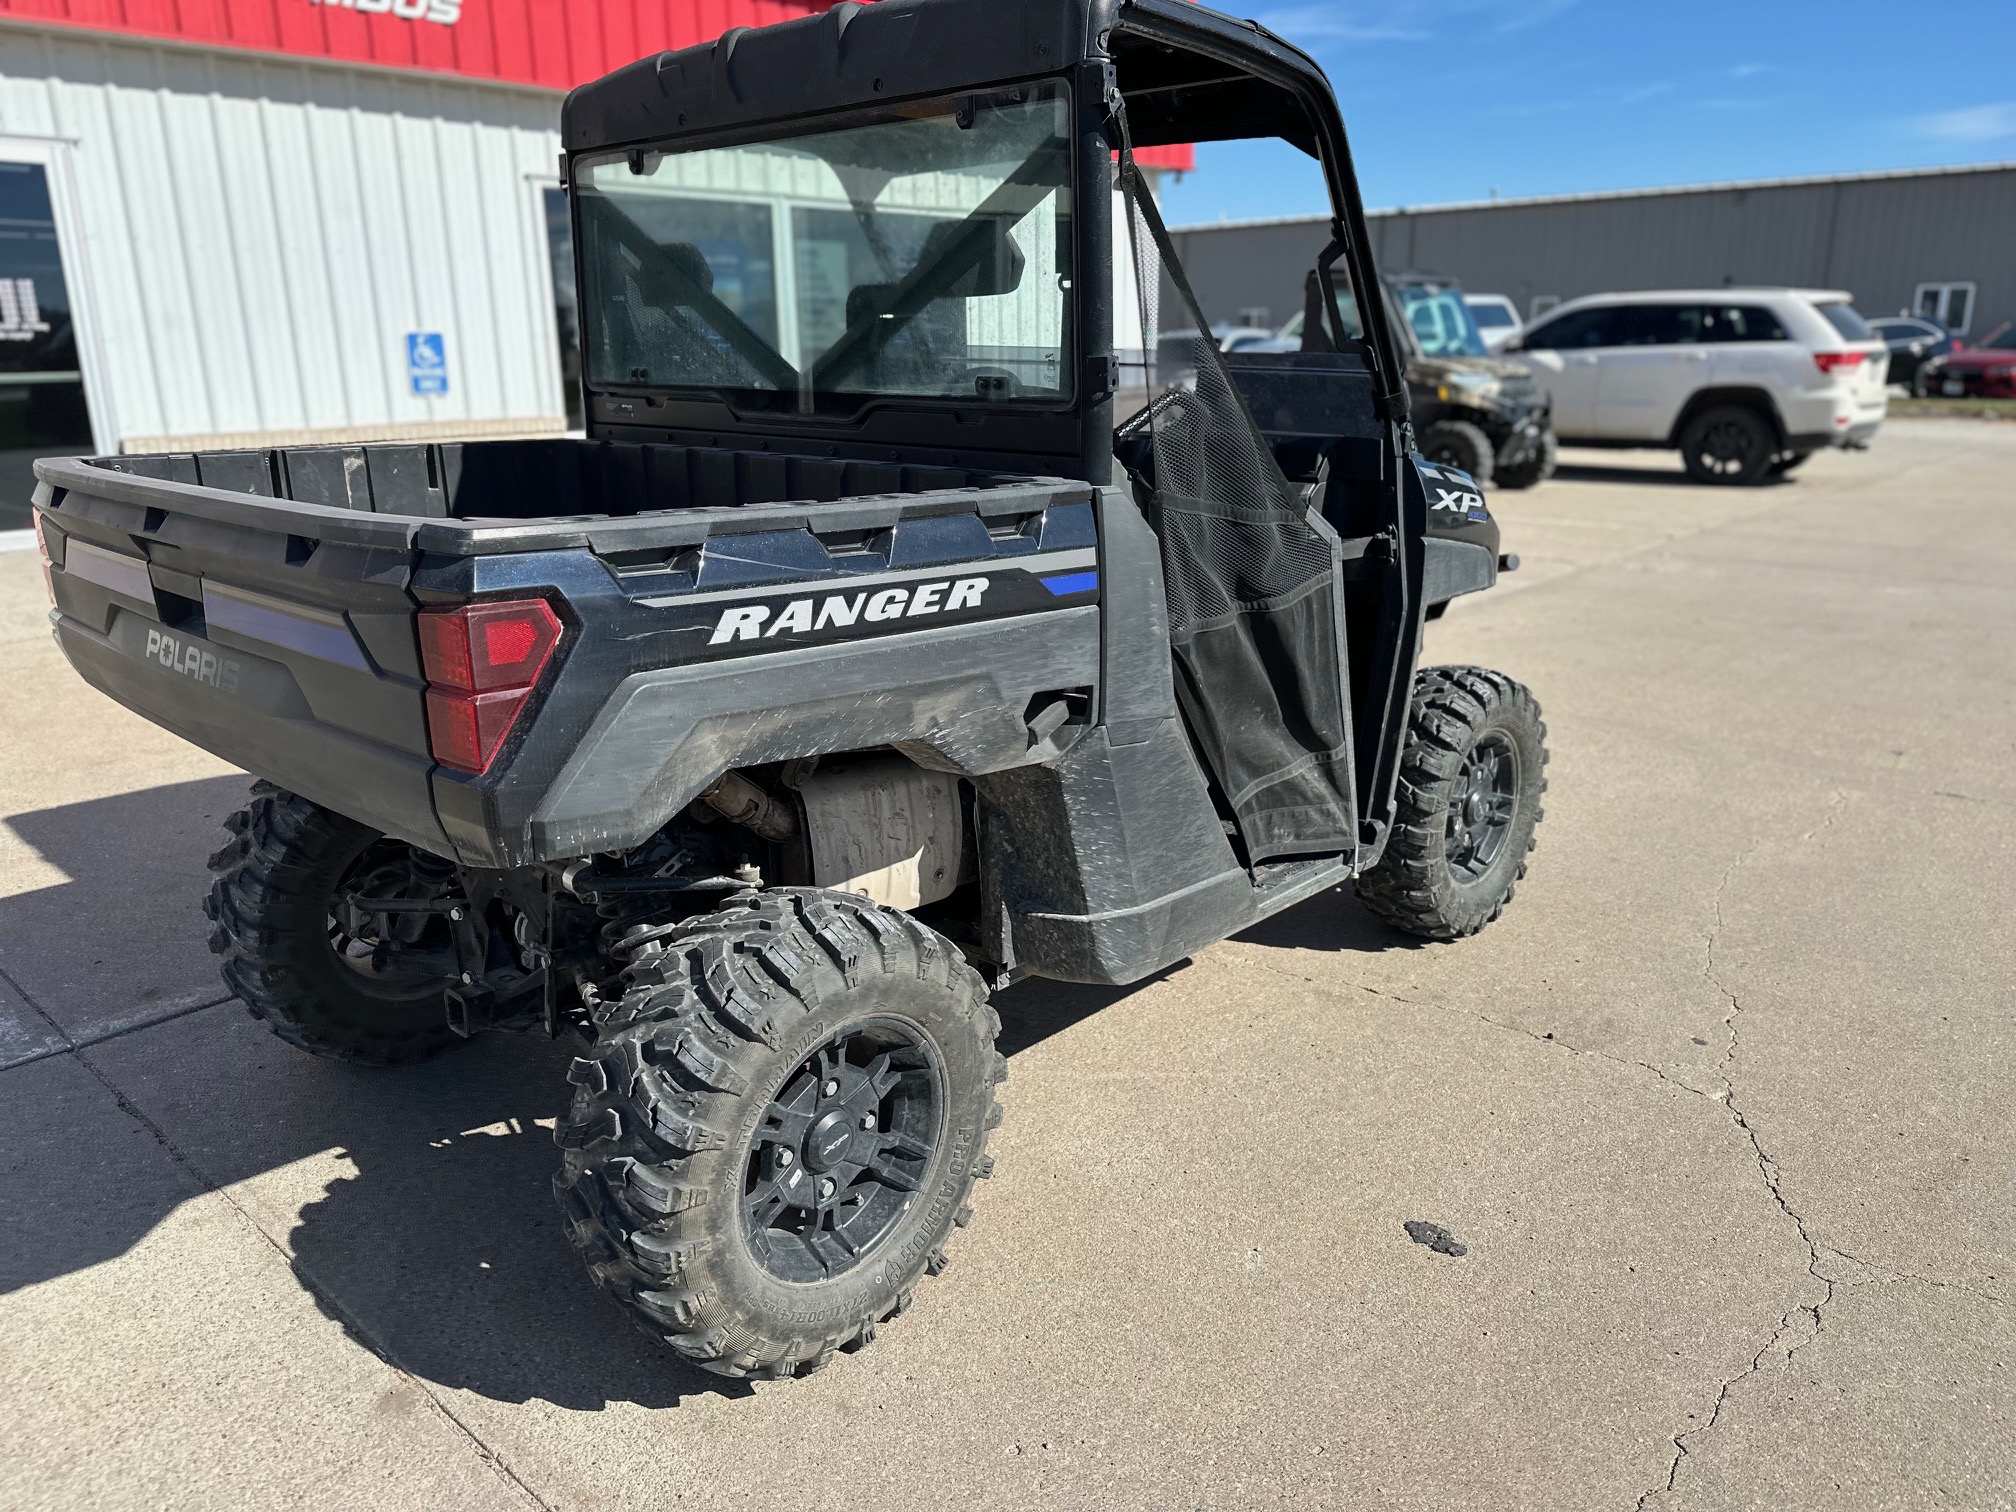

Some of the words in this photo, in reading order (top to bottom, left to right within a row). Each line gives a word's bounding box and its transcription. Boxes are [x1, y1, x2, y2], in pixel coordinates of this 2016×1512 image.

[1431, 488, 1483, 513] XP
[707, 577, 990, 645] RANGER
[146, 629, 241, 694] POLARIS
[949, 1127, 974, 1176] PRO
[901, 1179, 957, 1263] ARMOR
